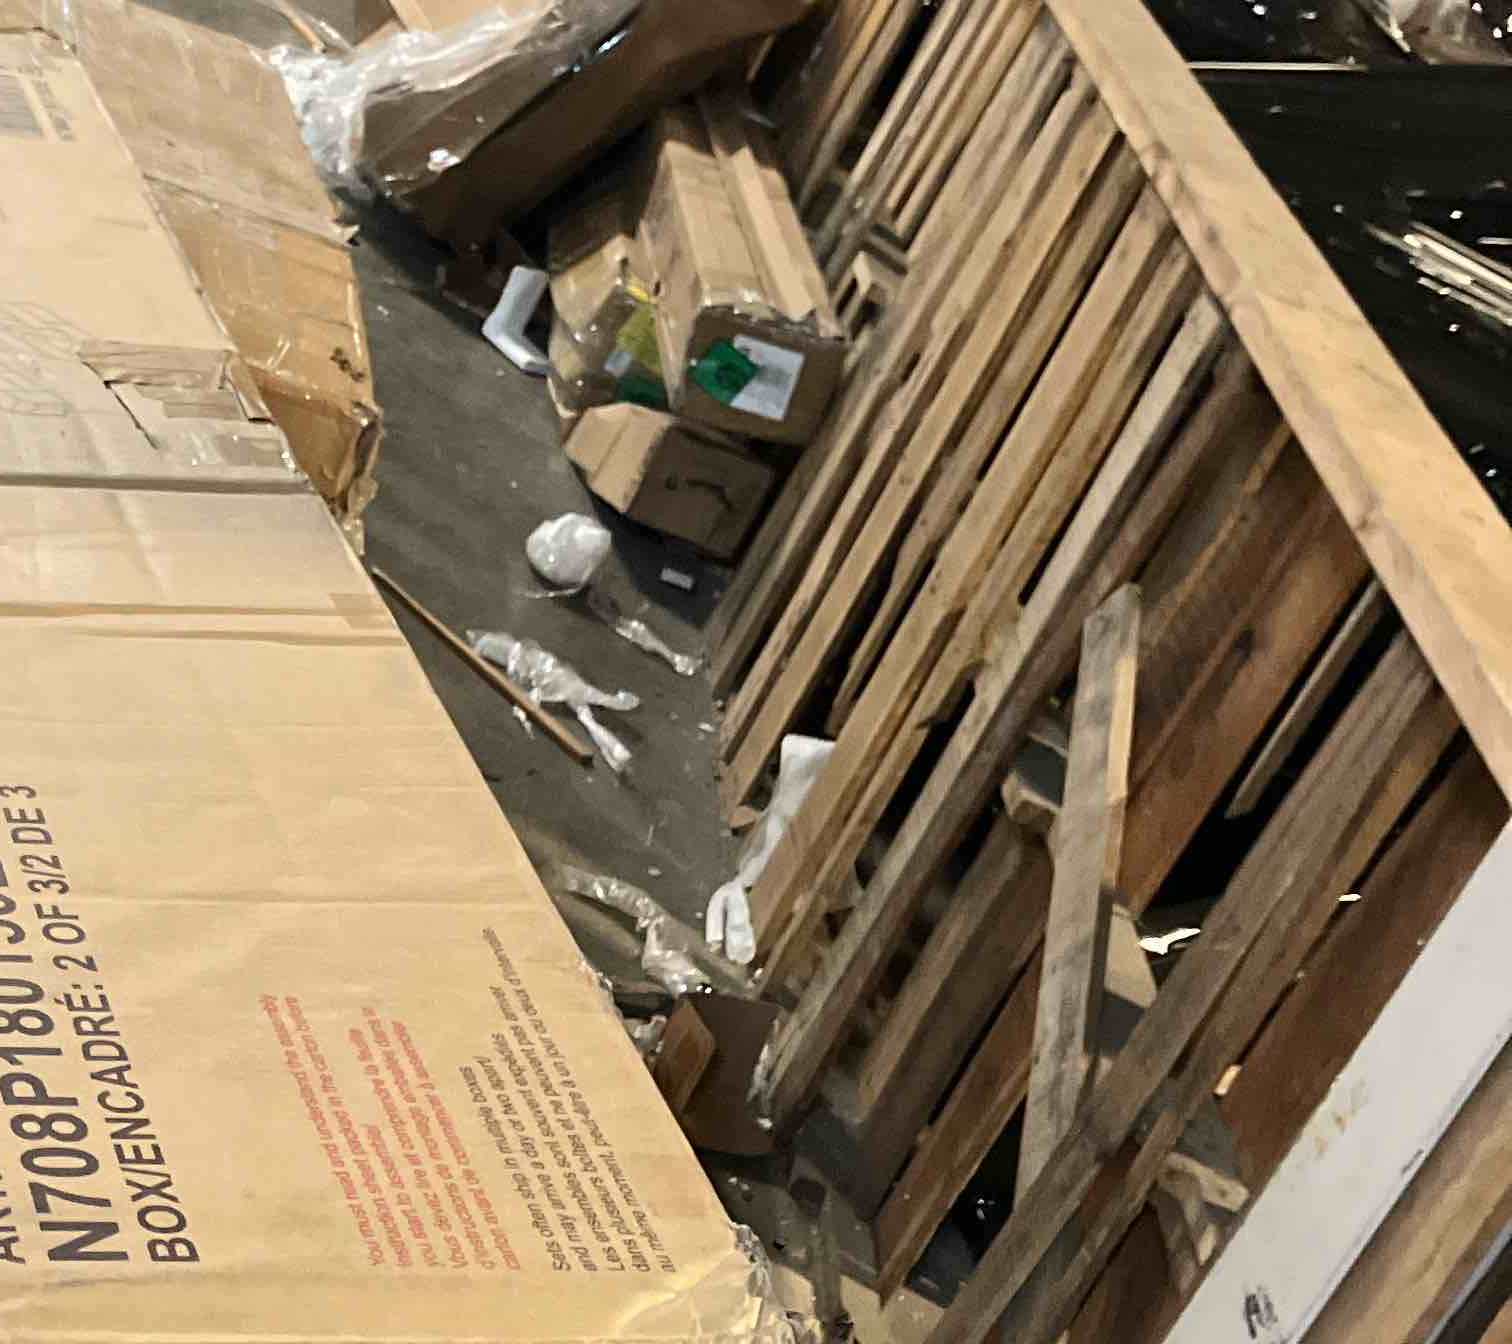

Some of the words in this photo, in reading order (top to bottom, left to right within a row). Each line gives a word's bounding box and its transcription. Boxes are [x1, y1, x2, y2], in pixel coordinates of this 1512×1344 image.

[0, 785, 38, 798] 3
[6, 807, 53, 844] DE
[23, 854, 70, 893] 3/2
[37, 904, 86, 944] OF
[55, 955, 99, 971] 2
[61, 985, 198, 1261] BOX/ENCADRÉ:
[512, 1173, 535, 1199] ship
[527, 1203, 553, 1237] often
[557, 1213, 580, 1241] may
[545, 1240, 570, 1270] Sets
[568, 1246, 597, 1271] and
[602, 1246, 625, 1270] Les
